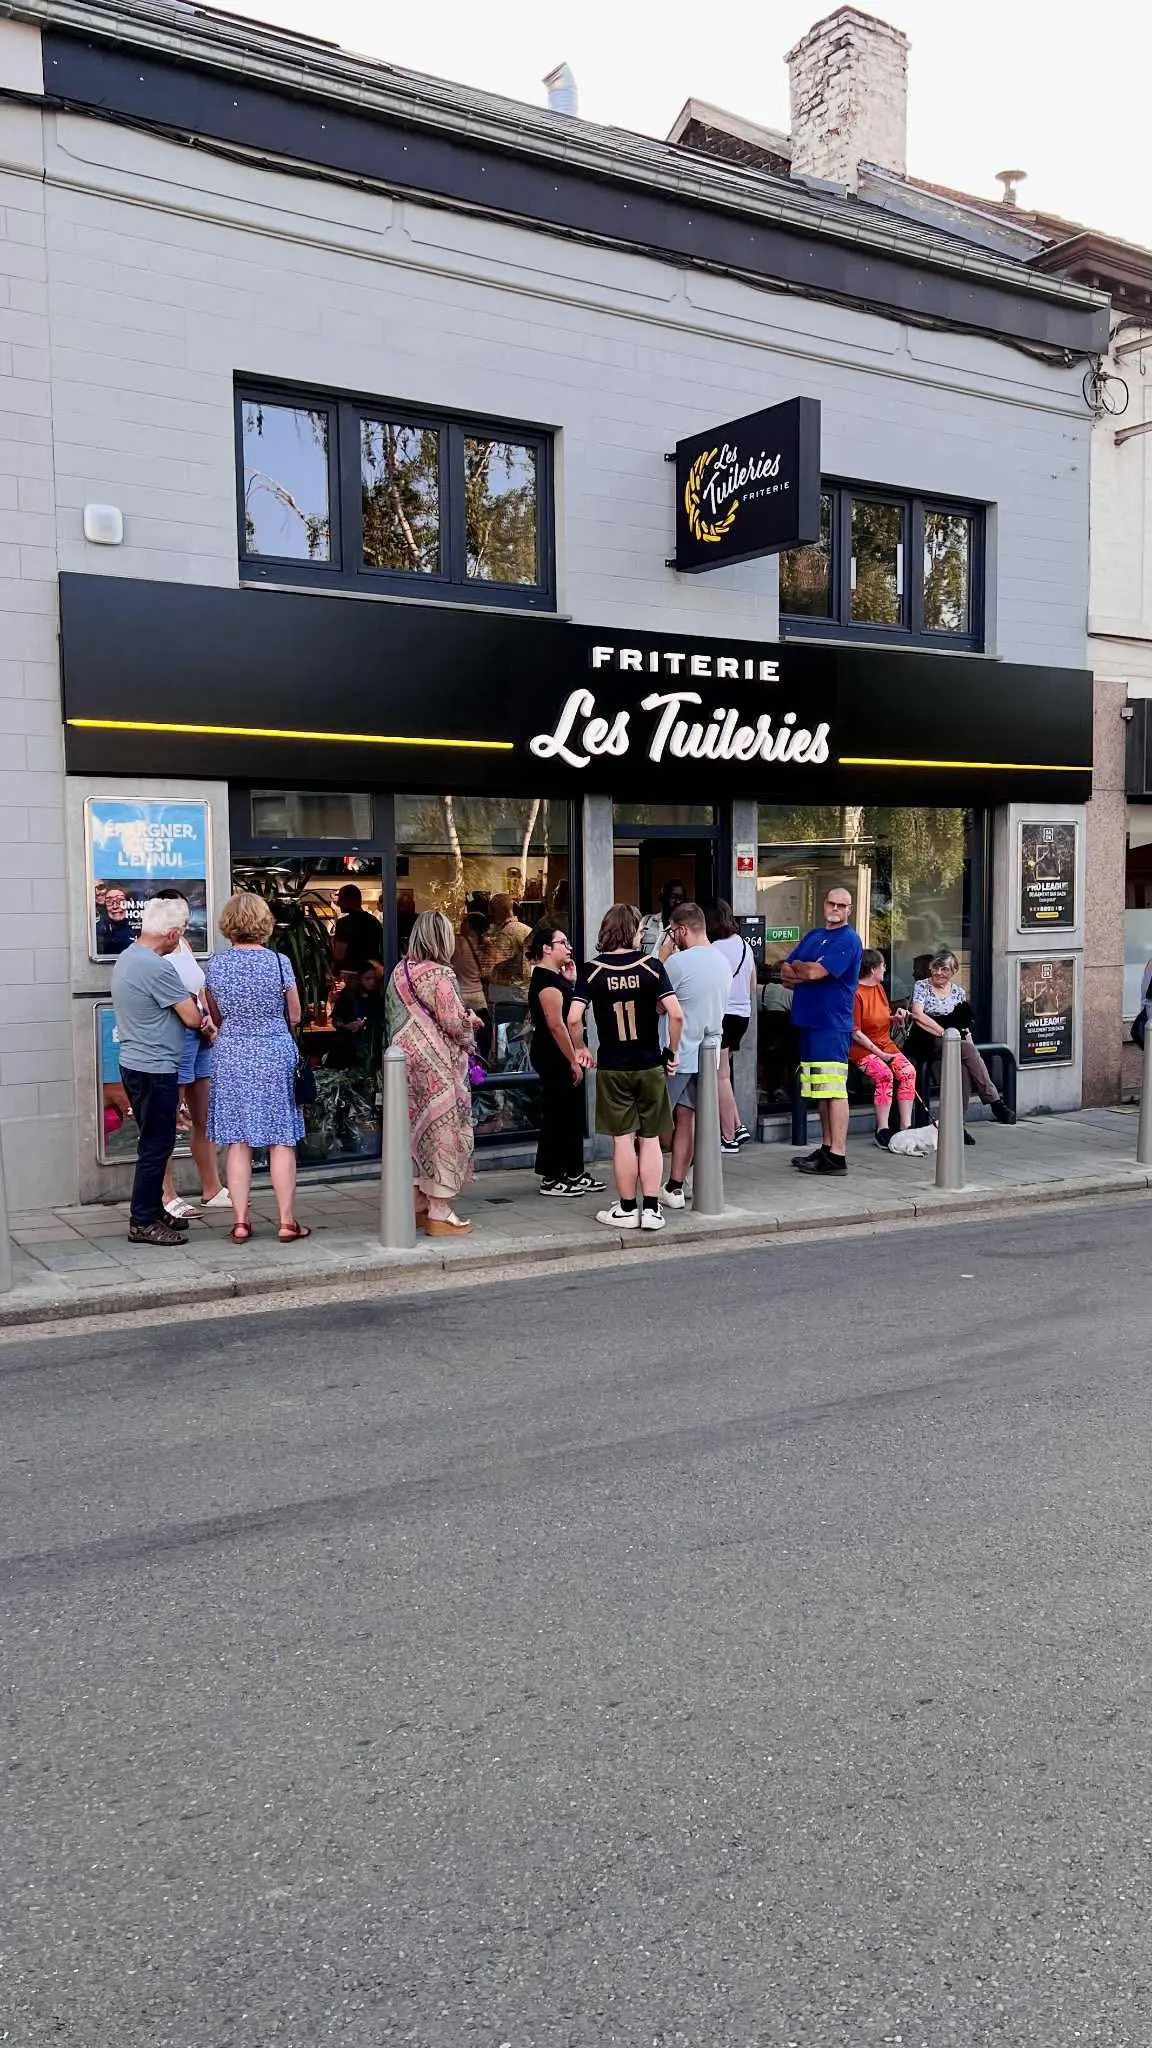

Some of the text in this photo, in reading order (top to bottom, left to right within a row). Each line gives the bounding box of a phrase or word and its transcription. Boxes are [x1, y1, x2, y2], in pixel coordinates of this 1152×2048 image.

[714, 444, 737, 469] Les
[703, 451, 781, 514] Tuileries
[743, 482, 790, 502] FRITERIE
[592, 646, 780, 682] FRITERIE
[529, 688, 831, 768] Les Tuileries
[772, 930, 793, 939] OPEN
[607, 975, 640, 990] ISAGI
[613, 1000, 638, 1041] 11
